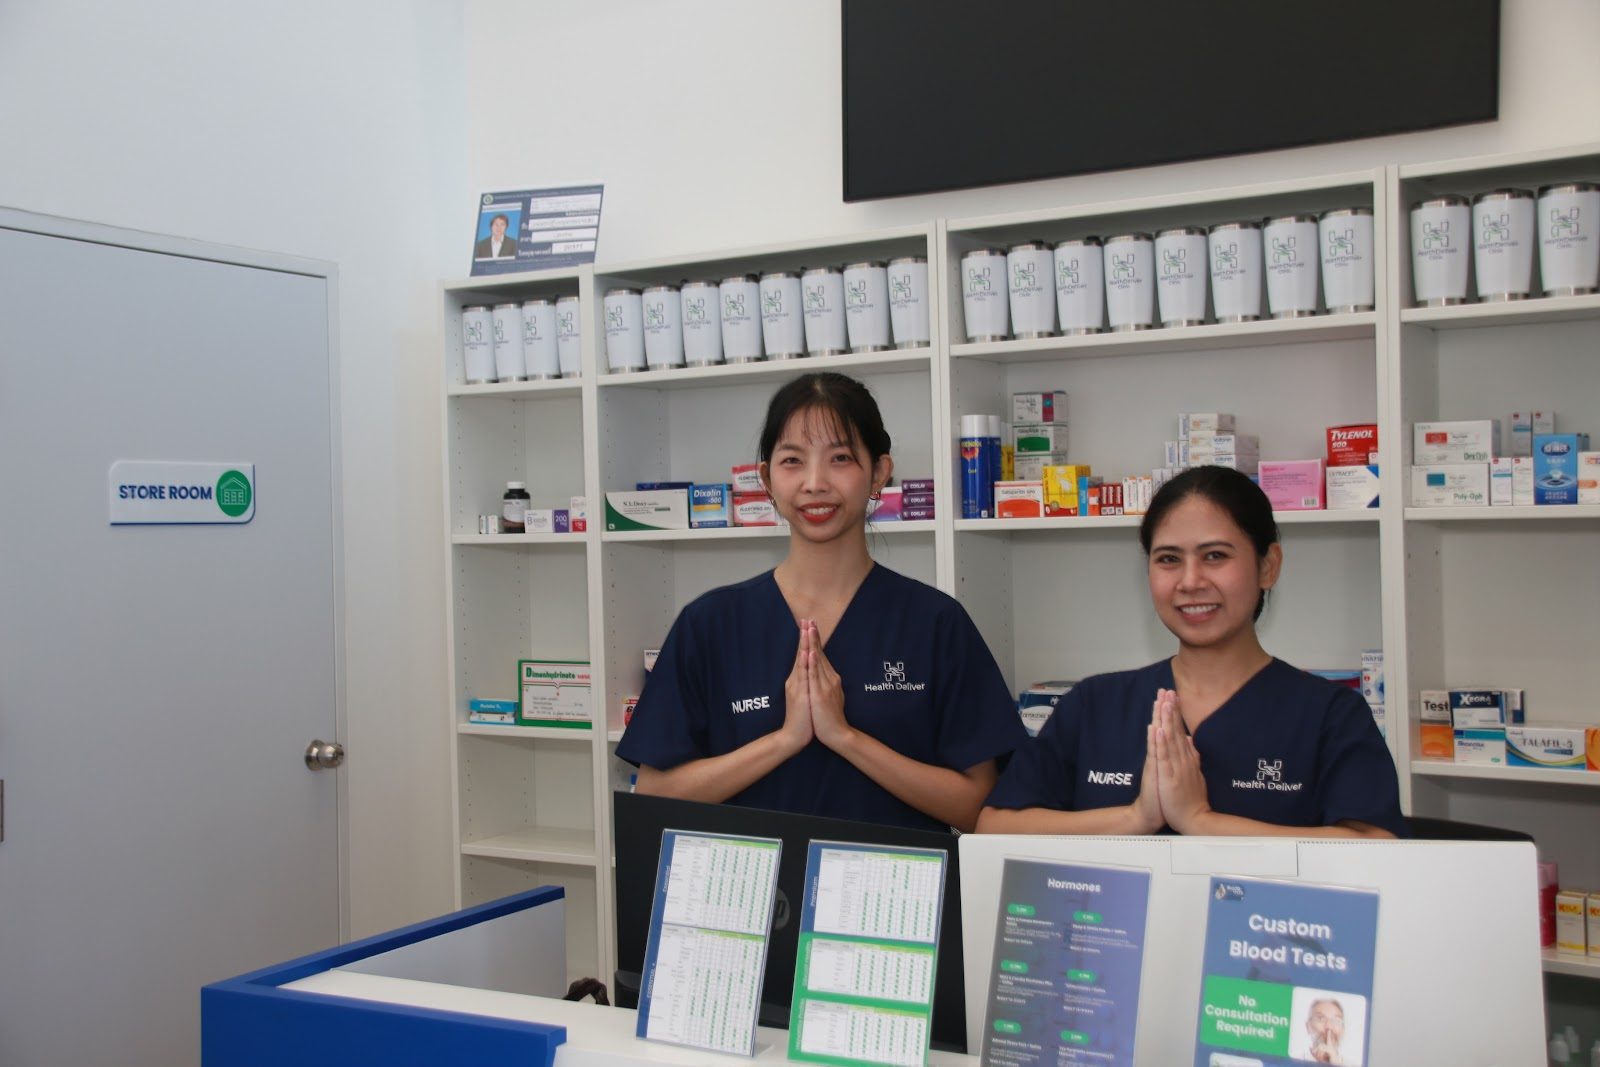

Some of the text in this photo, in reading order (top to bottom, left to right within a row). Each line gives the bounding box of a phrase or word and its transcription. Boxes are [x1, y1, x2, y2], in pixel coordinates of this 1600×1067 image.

[1330, 430, 1373, 441] TYLENOL
[1332, 441, 1347, 449] 500
[119, 485, 212, 500] STORE ROOM
[864, 682, 926, 692] Health Deliver
[731, 696, 770, 714] NURSE
[1424, 701, 1449, 711] Test
[1087, 770, 1133, 786] NURSE
[1232, 779, 1303, 792] Health Deliver
[1047, 878, 1102, 893] Hormones
[1248, 914, 1331, 939] Custom
[1229, 940, 1348, 971] Blood Tests
[1238, 994, 1256, 1007] No
[1204, 1004, 1288, 1027] Consultation
[1216, 1019, 1275, 1040] Required
